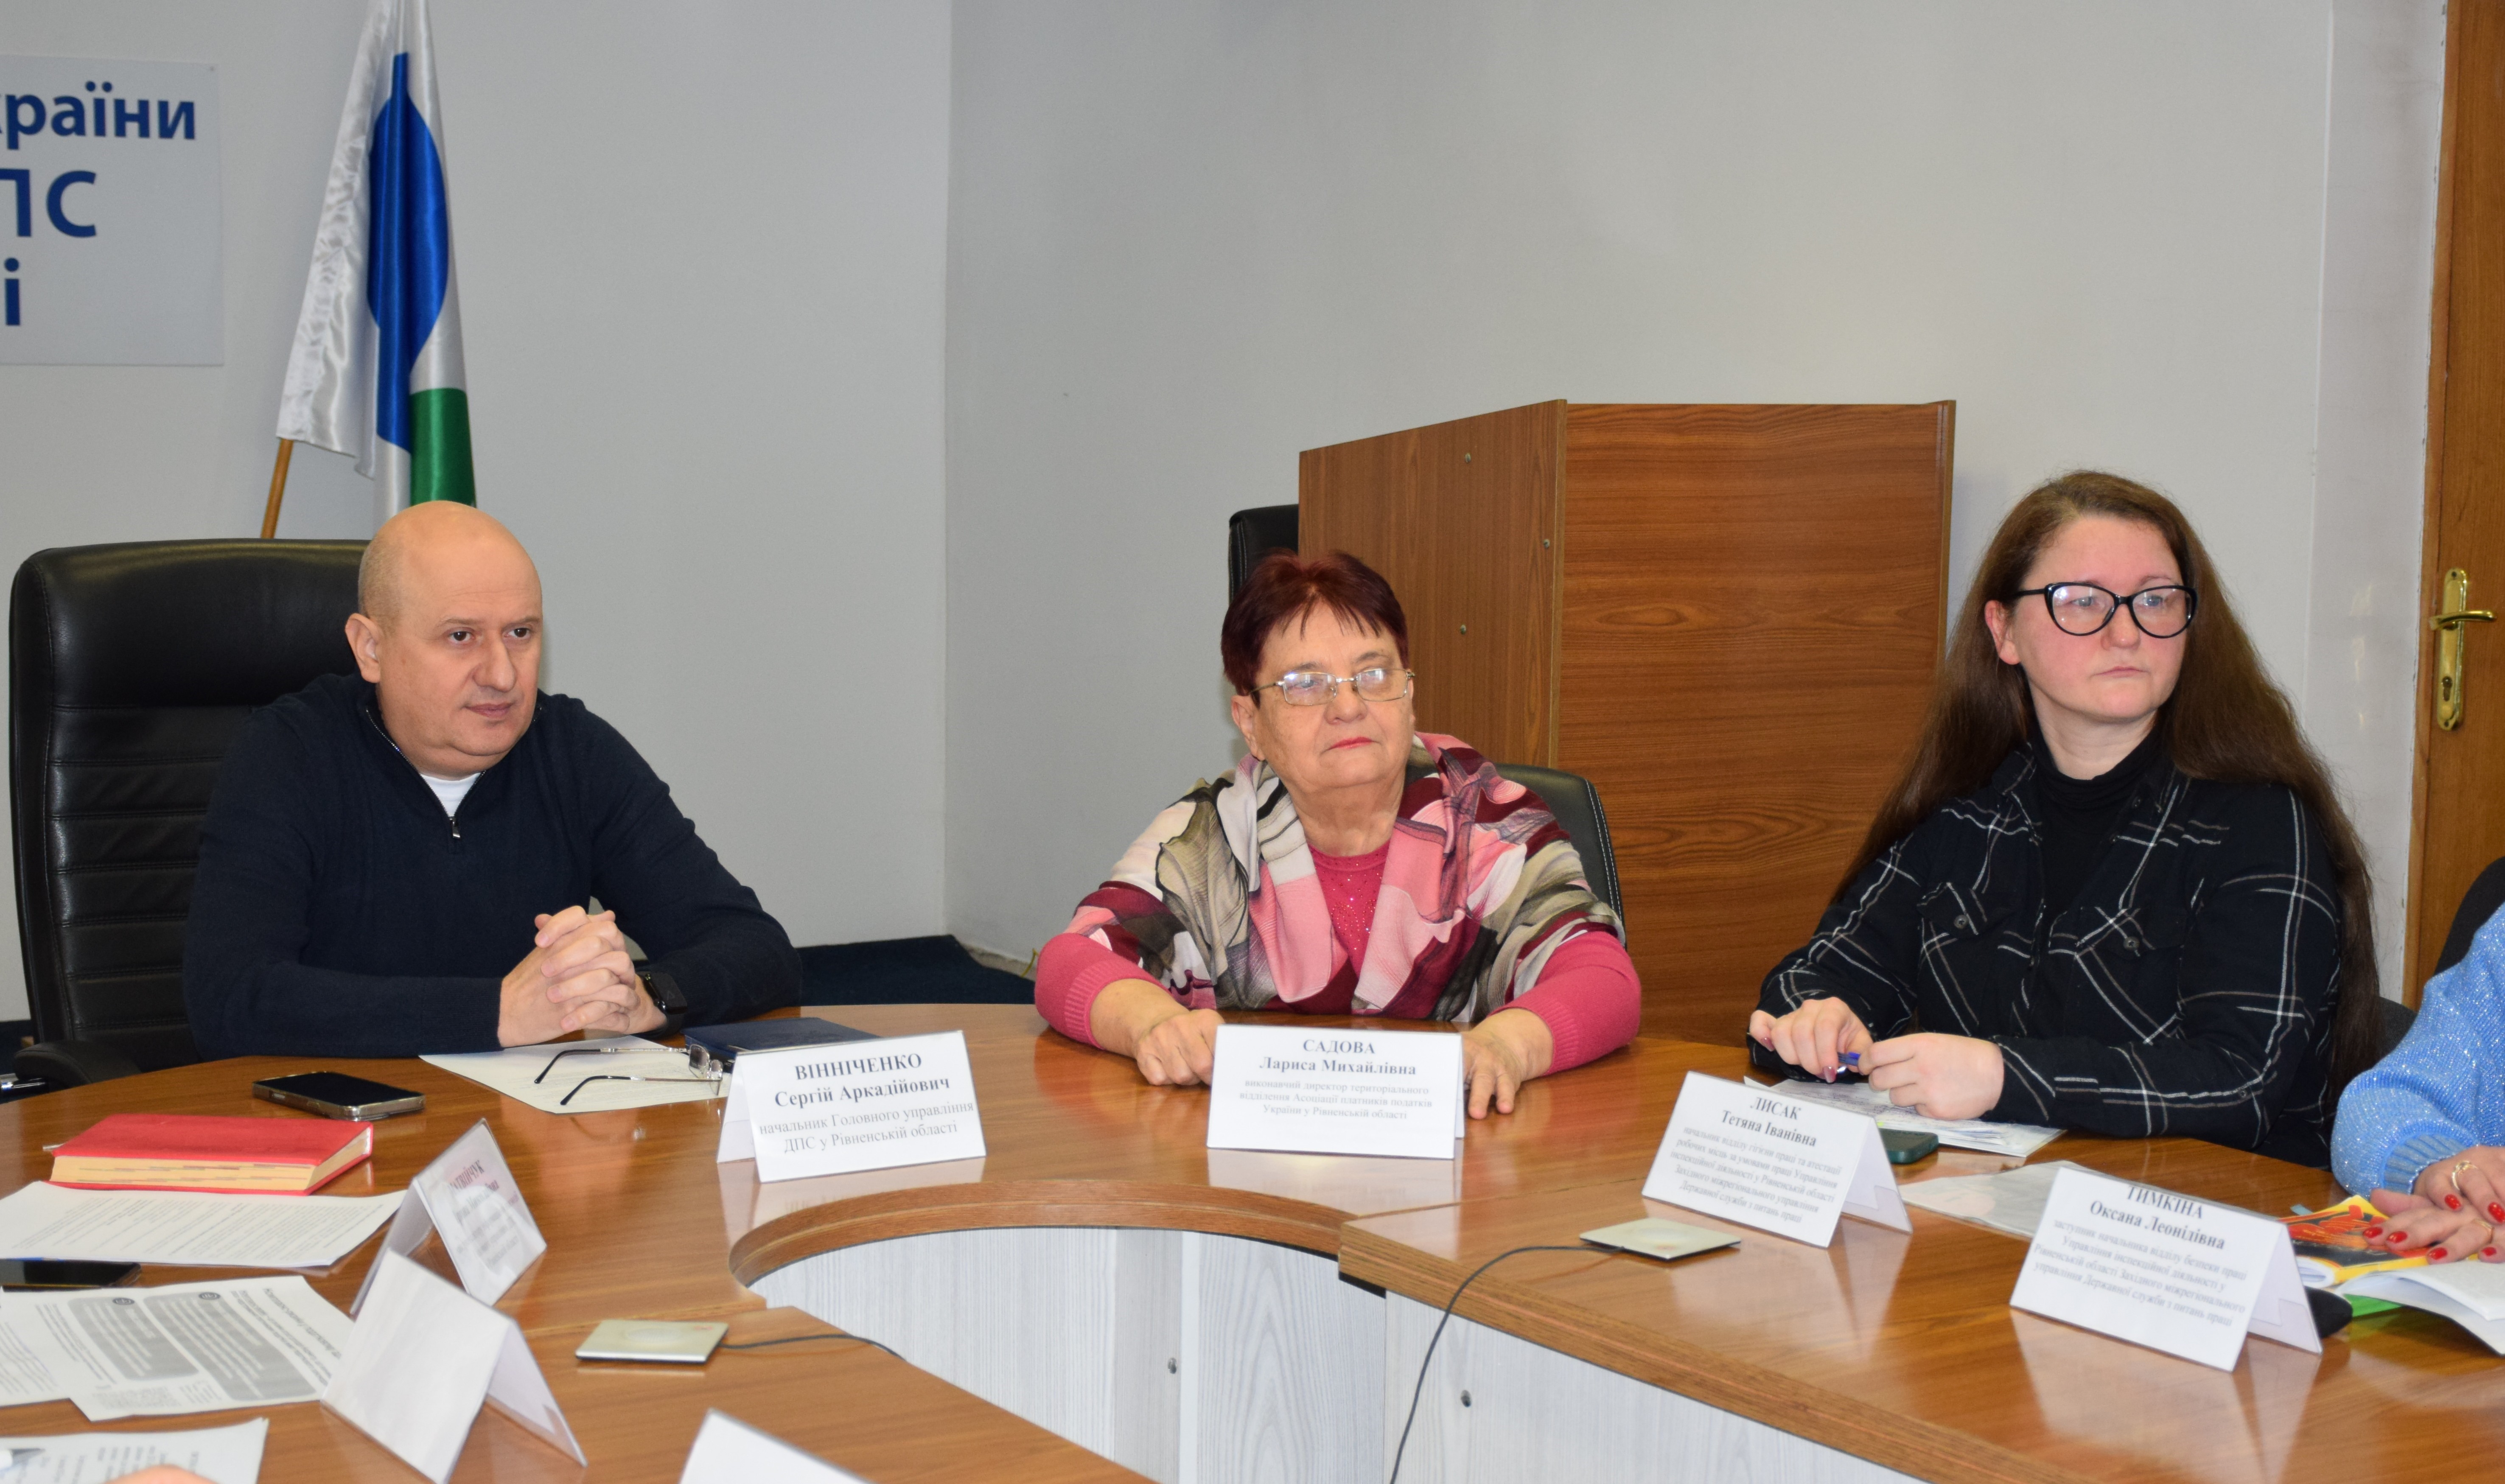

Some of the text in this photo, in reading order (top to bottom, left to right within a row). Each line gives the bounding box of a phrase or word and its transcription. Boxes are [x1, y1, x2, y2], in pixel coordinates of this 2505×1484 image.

[0, 81, 196, 150] раїни
[1303, 1039, 1375, 1054] САДОВА
[795, 1053, 922, 1080] ВІННІЧЕНКО
[1259, 1057, 1416, 1075] Лариса Михайлівна
[774, 1078, 950, 1109] Сергій Аркадійович
[1239, 1092, 1290, 1101] відділення
[1293, 1093, 1338, 1103] Асоціації
[1391, 1100, 1432, 1108] податків
[1244, 1080, 1429, 1095] виконавчий директор територіального
[759, 1101, 974, 1135] начальник Головного управління
[1263, 1104, 1407, 1119] України у Рівненській області
[1750, 1097, 1802, 1120] ЛИСАК
[784, 1120, 957, 1154] ДПС у Рівненській області
[1722, 1110, 1817, 1147] Тетяна Іванівна
[1683, 1127, 1721, 1142] начальник
[1721, 1137, 1748, 1151] відділу
[1775, 1152, 1797, 1163] праці
[1798, 1158, 1806, 1166] та
[1674, 1164, 1710, 1182] Західного
[1676, 1139, 1706, 1153] робочих
[1736, 1156, 1770, 1170] умовами
[1794, 1169, 1838, 1189] Управління
[1678, 1180, 1720, 1198] Державної
[1719, 1194, 1747, 1207] служби
[1753, 1175, 1760, 1184] у
[1760, 1174, 1805, 1195] Рівненській
[1806, 1188, 1835, 1203] області
[2127, 1184, 2202, 1219] ТИМКІНА
[2090, 1201, 2225, 1250] Оксана Леонідівна
[2053, 1220, 2247, 1281] заступник начальника відділу безпеки праці
[2062, 1235, 2113, 1259] Управління
[2218, 1283, 2226, 1293] у
[2033, 1262, 2083, 1282] управління
[2082, 1274, 2131, 1296] Державної
[2132, 1291, 2166, 1307] служби
[2085, 1260, 2118, 1277] області
[2120, 1268, 2163, 1289] Західного
